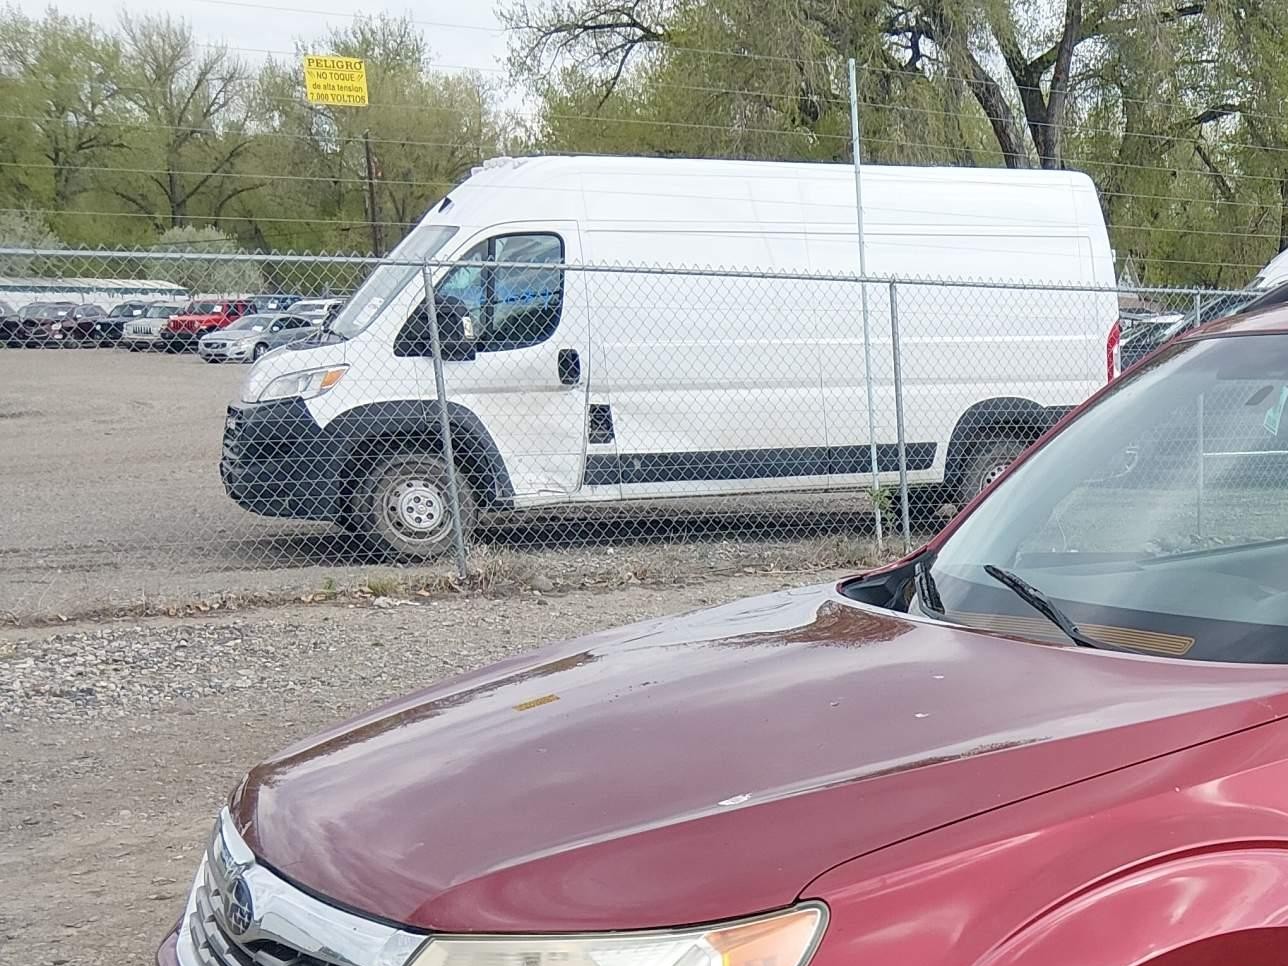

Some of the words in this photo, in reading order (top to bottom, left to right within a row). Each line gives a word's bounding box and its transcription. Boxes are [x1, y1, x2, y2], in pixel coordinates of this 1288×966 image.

[307, 58, 364, 70] PELIGRO
[316, 71, 328, 80] NO
[329, 72, 355, 82] TOQUE
[322, 82, 336, 91] alta
[330, 93, 366, 104] VOLTIOS
